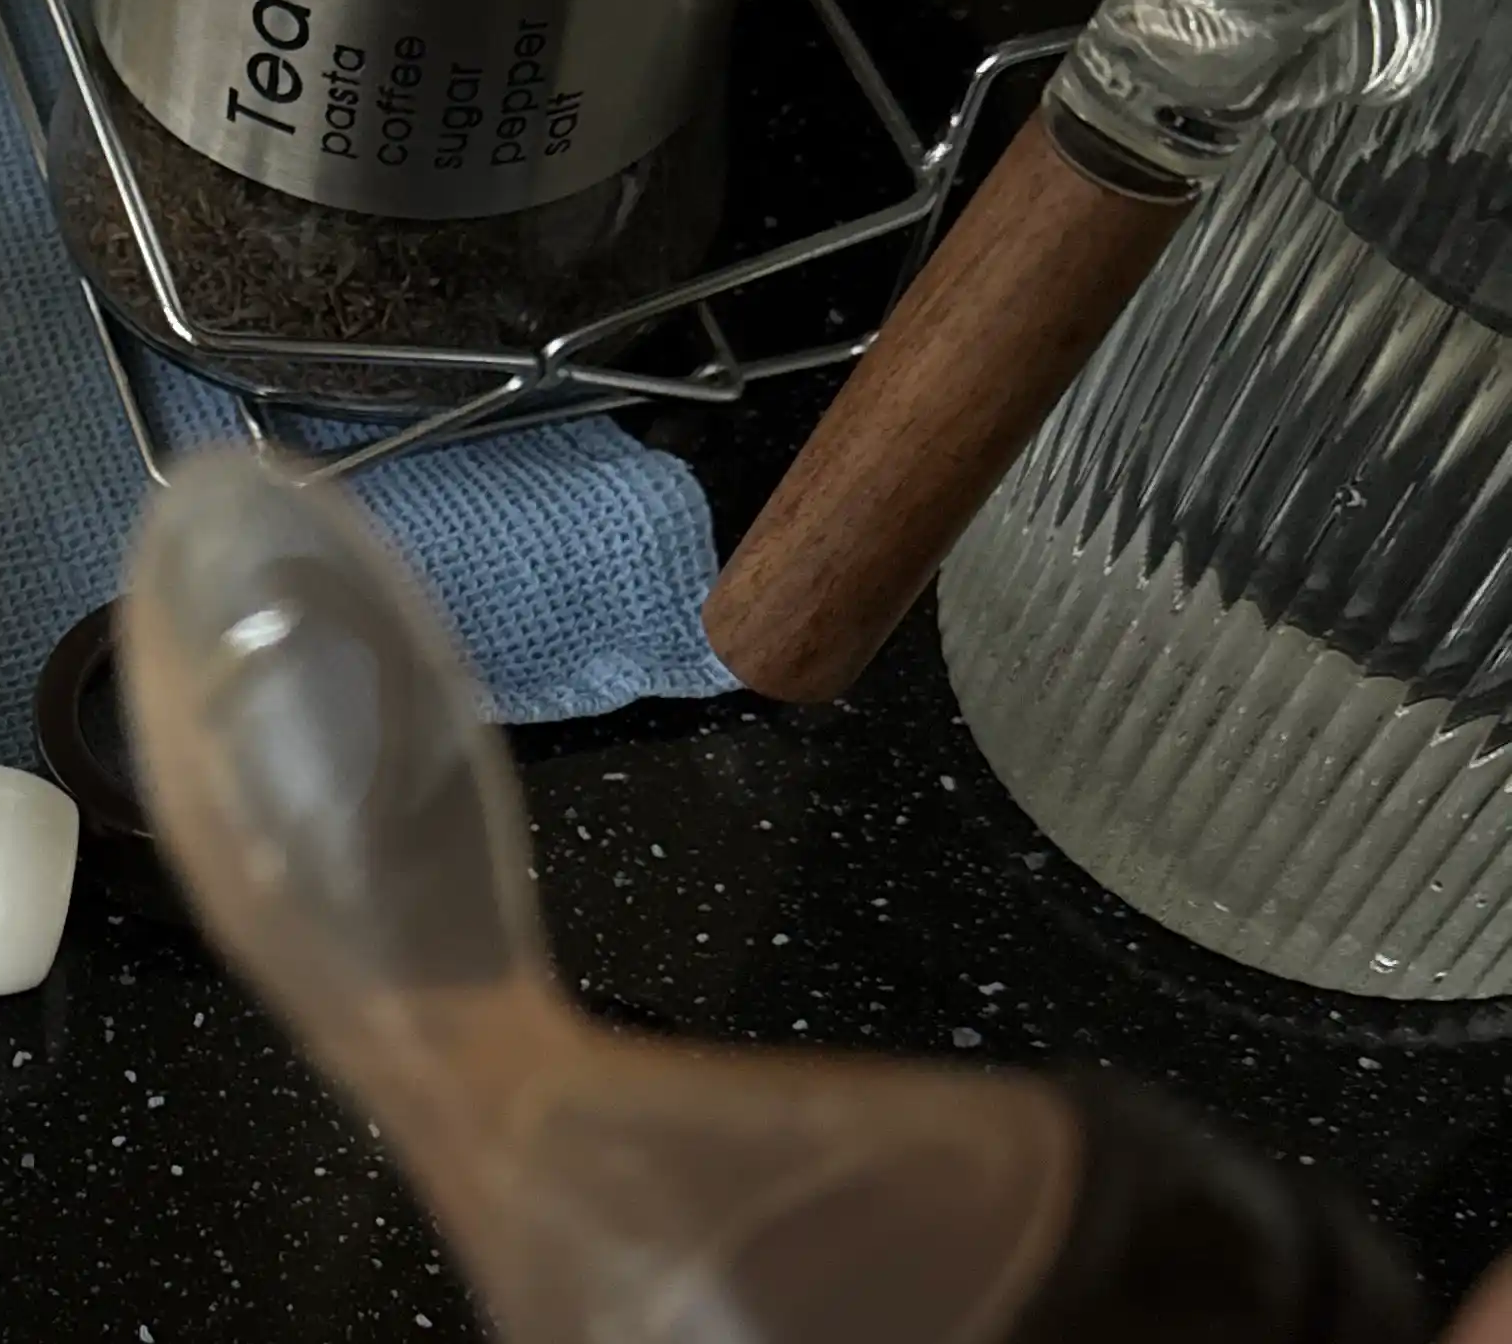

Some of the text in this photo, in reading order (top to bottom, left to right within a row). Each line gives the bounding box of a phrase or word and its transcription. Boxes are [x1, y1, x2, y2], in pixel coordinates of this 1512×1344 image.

[320, 44, 365, 159] pasta
[377, 36, 426, 167] coffee
[435, 62, 485, 170] sugar
[490, 18, 549, 167] pepper
[545, 90, 584, 157] salt
